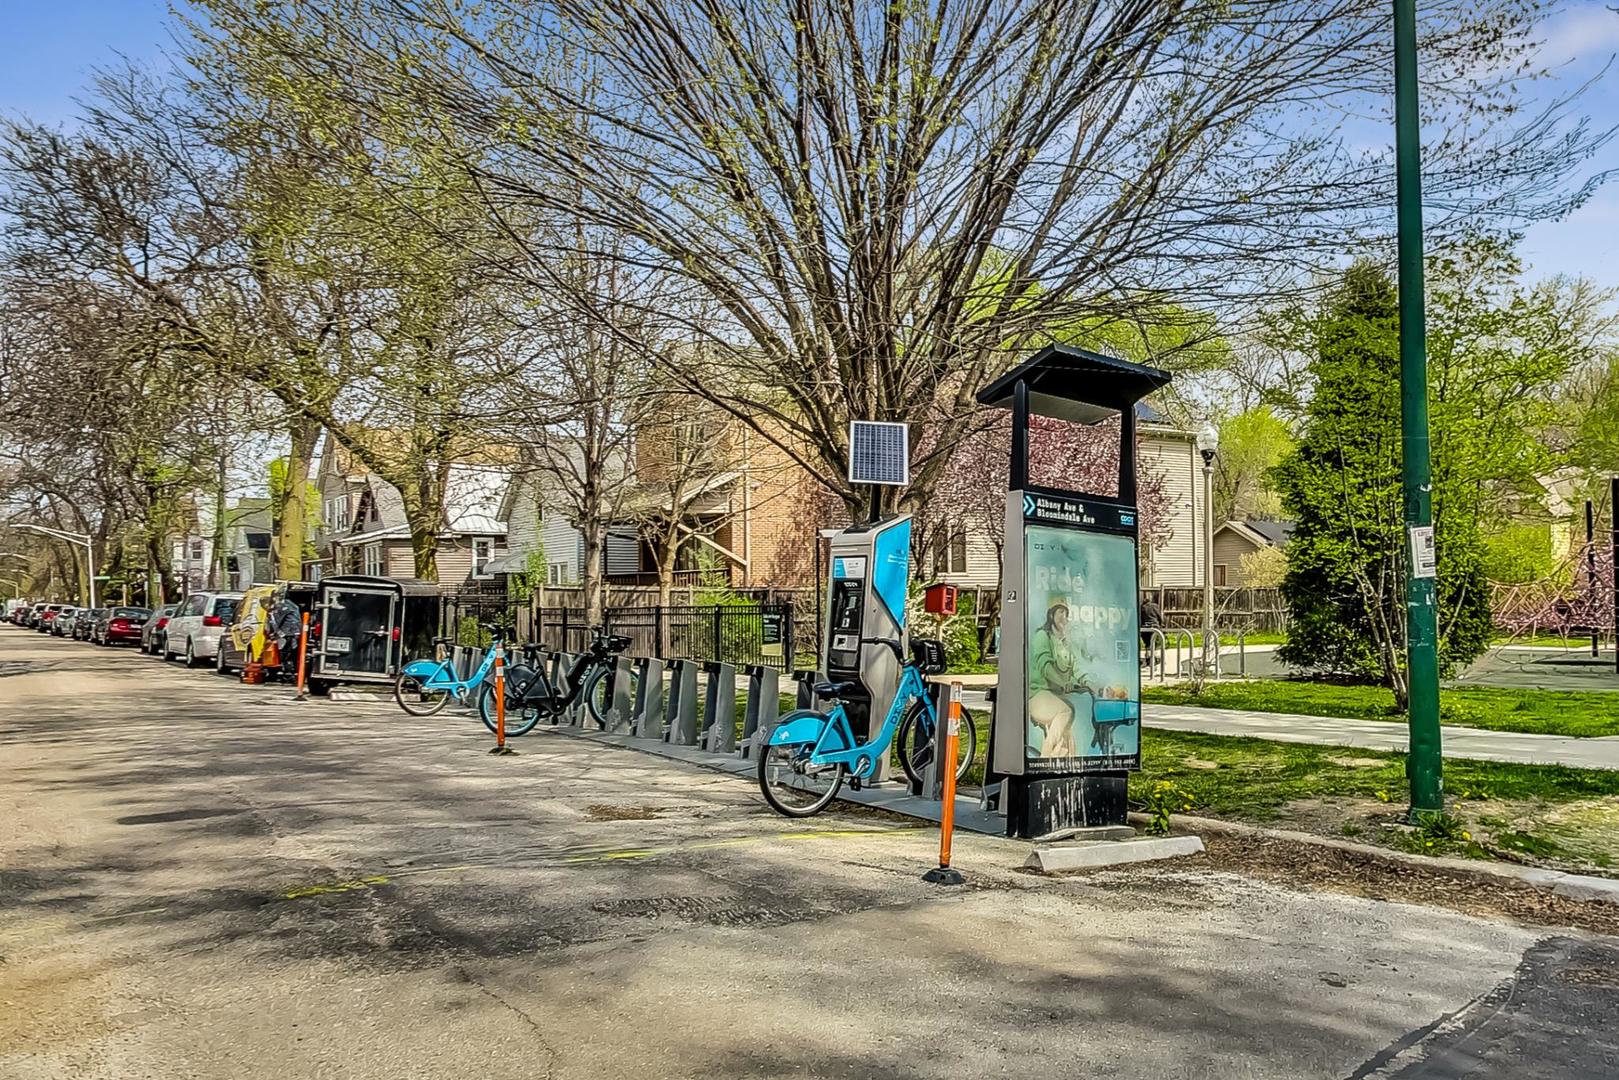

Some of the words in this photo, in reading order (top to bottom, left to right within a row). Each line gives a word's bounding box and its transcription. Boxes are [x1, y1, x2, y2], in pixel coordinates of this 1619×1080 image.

[1036, 498, 1062, 511] Albany
[1063, 501, 1077, 512] Ave
[1078, 503, 1085, 513] &
[1082, 514, 1096, 524] Ave
[1035, 565, 1085, 593] Ride
[1066, 596, 1132, 631] happy
